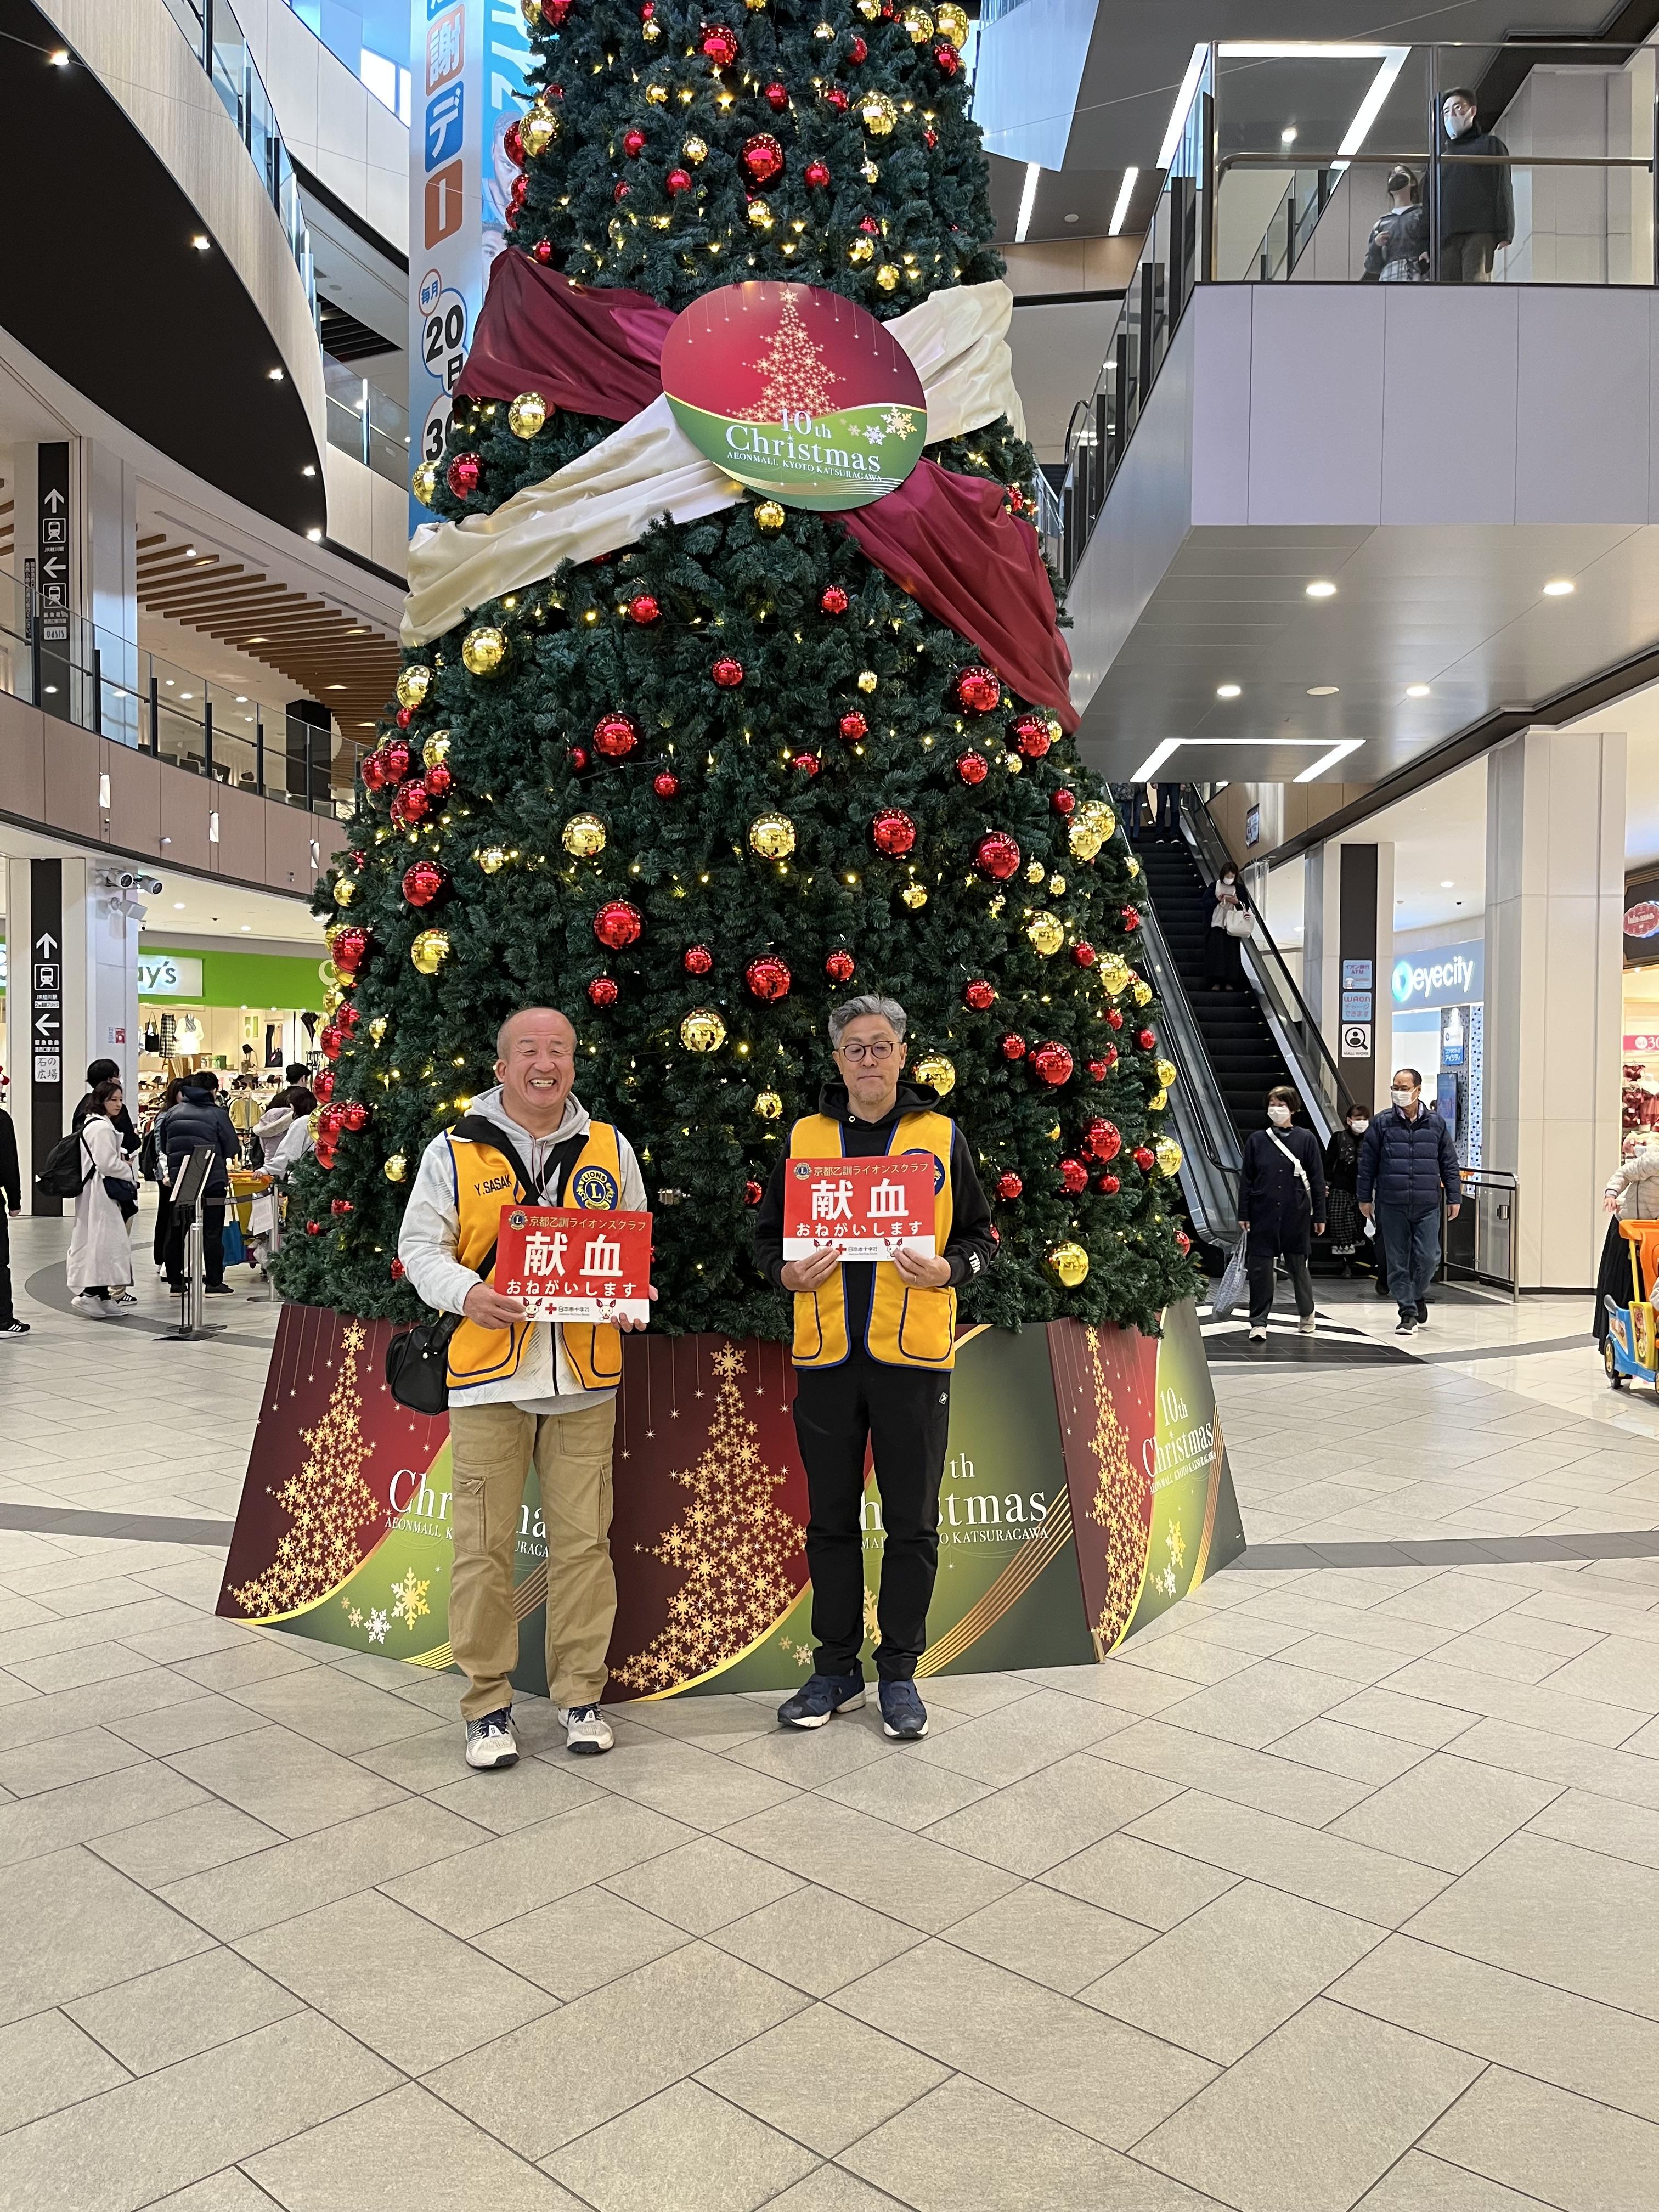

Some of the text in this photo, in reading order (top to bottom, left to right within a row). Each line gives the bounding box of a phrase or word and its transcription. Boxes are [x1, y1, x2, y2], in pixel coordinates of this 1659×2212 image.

[429, 0, 461, 231] 謝デー
[421, 280, 438, 305] 毎月
[781, 408, 832, 439] 10th
[726, 425, 881, 472] Christmas
[727, 452, 883, 482] AEONMALL KYOTO KATSURAGAWA
[1413, 955, 1474, 998] eyecity
[37, 1058, 57, 1066] 石の
[37, 1069, 58, 1080] 広場
[583, 1172, 606, 1181] LIONS
[590, 1183, 602, 1199] L
[795, 1220, 923, 1237] おねがいします
[506, 1279, 637, 1297] おねがいします
[1160, 1387, 1188, 1426] 10th
[1142, 1422, 1214, 1477] Christmas
[385, 1517, 441, 1538] AEONMALL
[953, 1527, 1049, 1544] KATSURAGAWA
